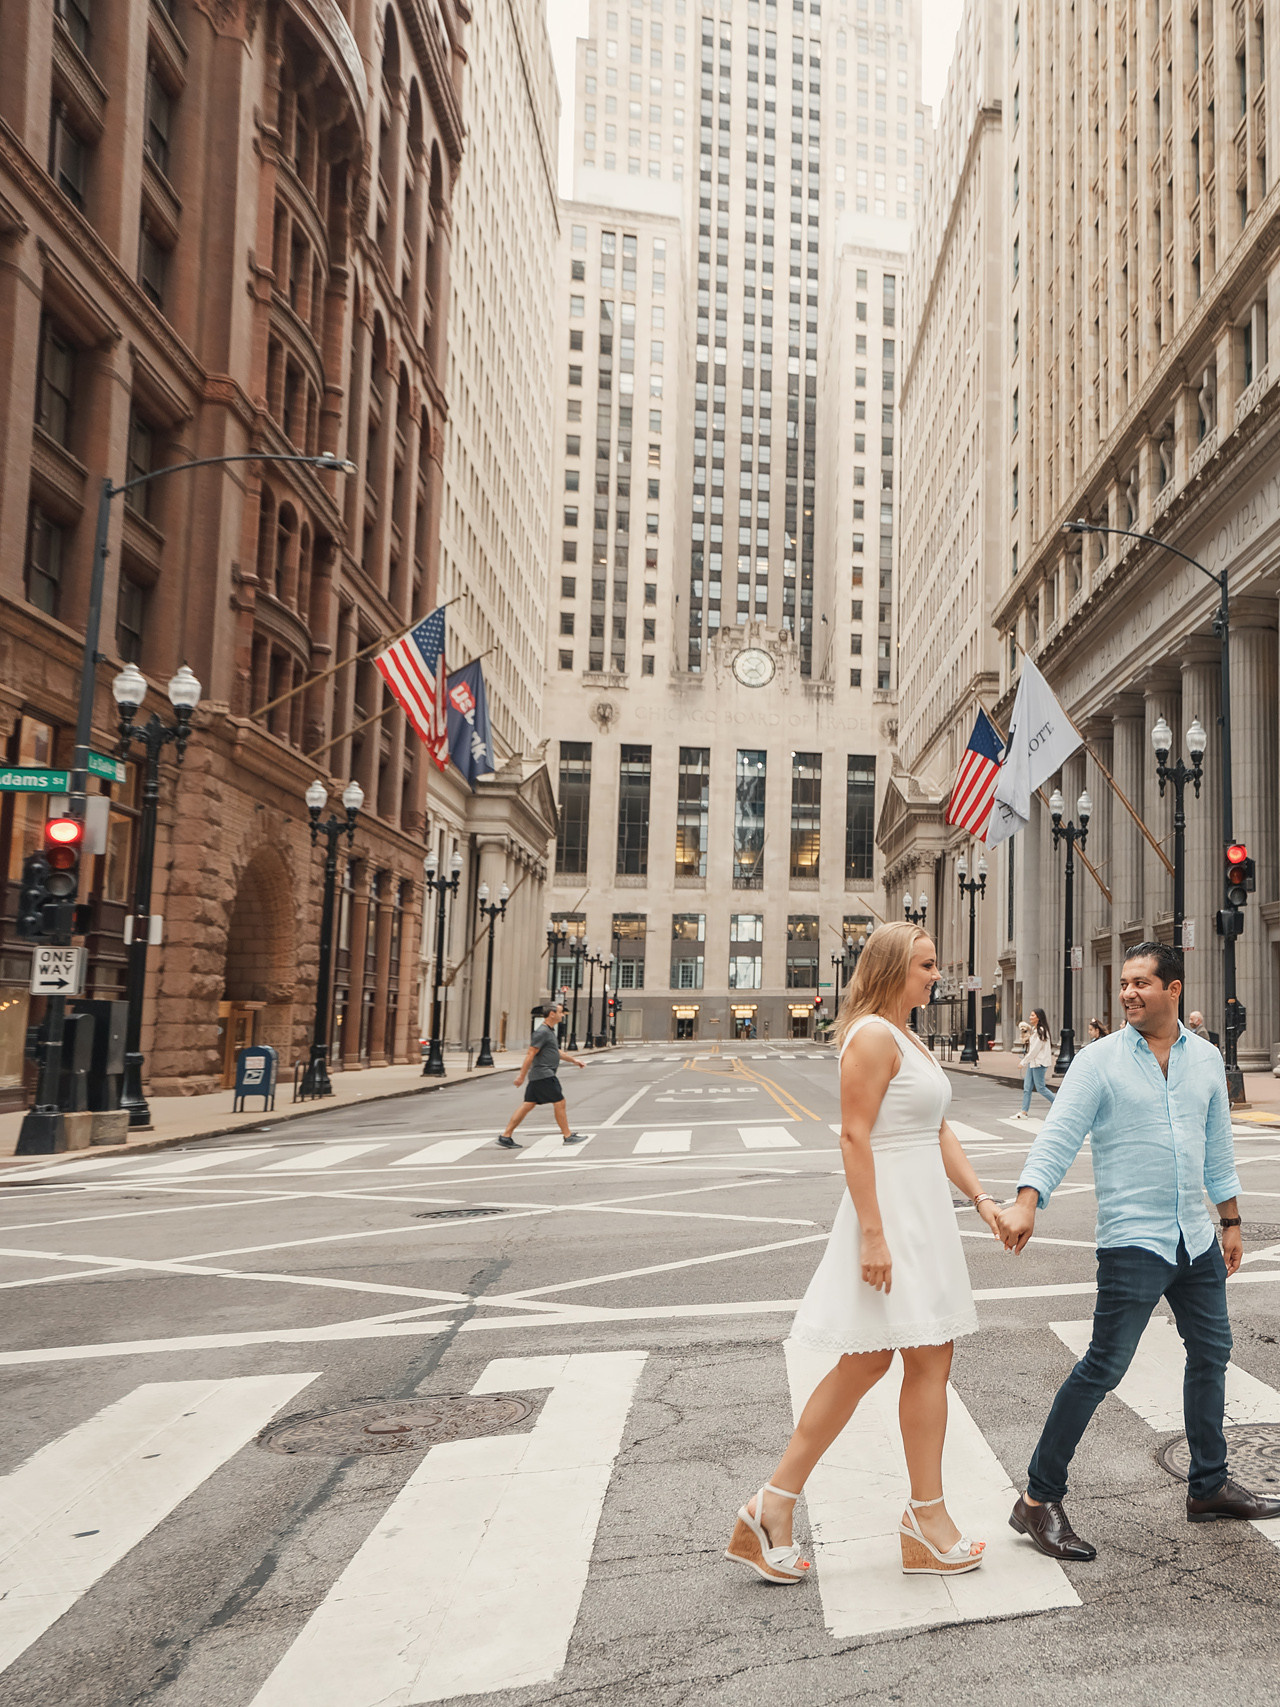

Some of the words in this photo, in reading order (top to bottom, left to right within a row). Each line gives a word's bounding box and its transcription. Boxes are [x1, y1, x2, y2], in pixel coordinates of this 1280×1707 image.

[1130, 602, 1153, 646] AND
[1160, 555, 1199, 616] TRUST
[634, 706, 718, 724] CHICAGO
[724, 711, 781, 728] BOARD
[788, 713, 809, 728] OF
[817, 715, 868, 731] TRADE
[0, 772, 49, 787] dams
[52, 776, 65, 786] St
[41, 951, 74, 962] ONE
[39, 964, 74, 975] WAY
